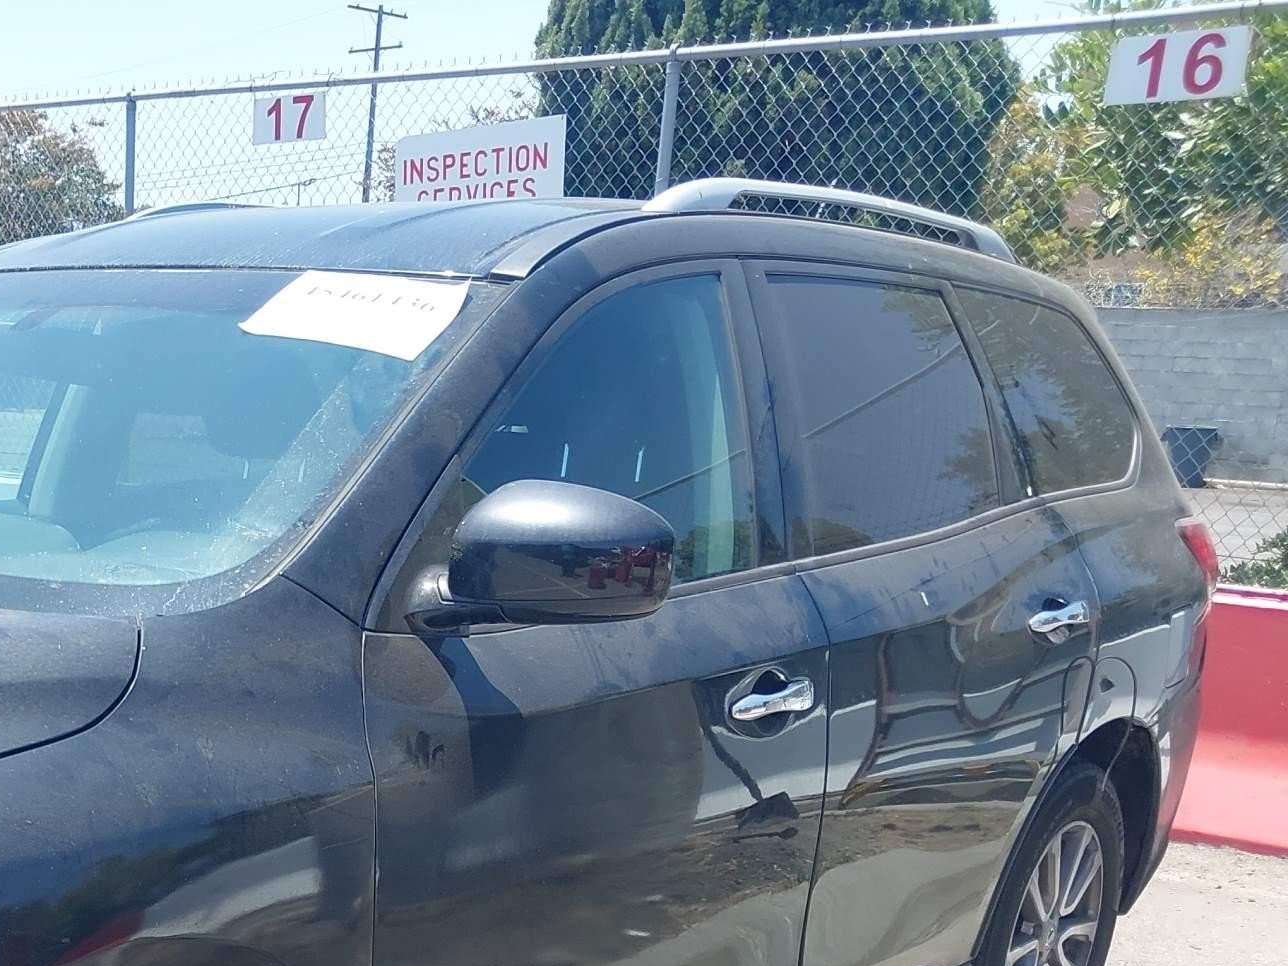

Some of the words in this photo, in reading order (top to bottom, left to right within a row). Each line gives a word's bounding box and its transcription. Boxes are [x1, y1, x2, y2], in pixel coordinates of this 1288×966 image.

[1137, 33, 1227, 98] 16
[267, 94, 314, 141] 17
[403, 142, 548, 185] INSPECTION
